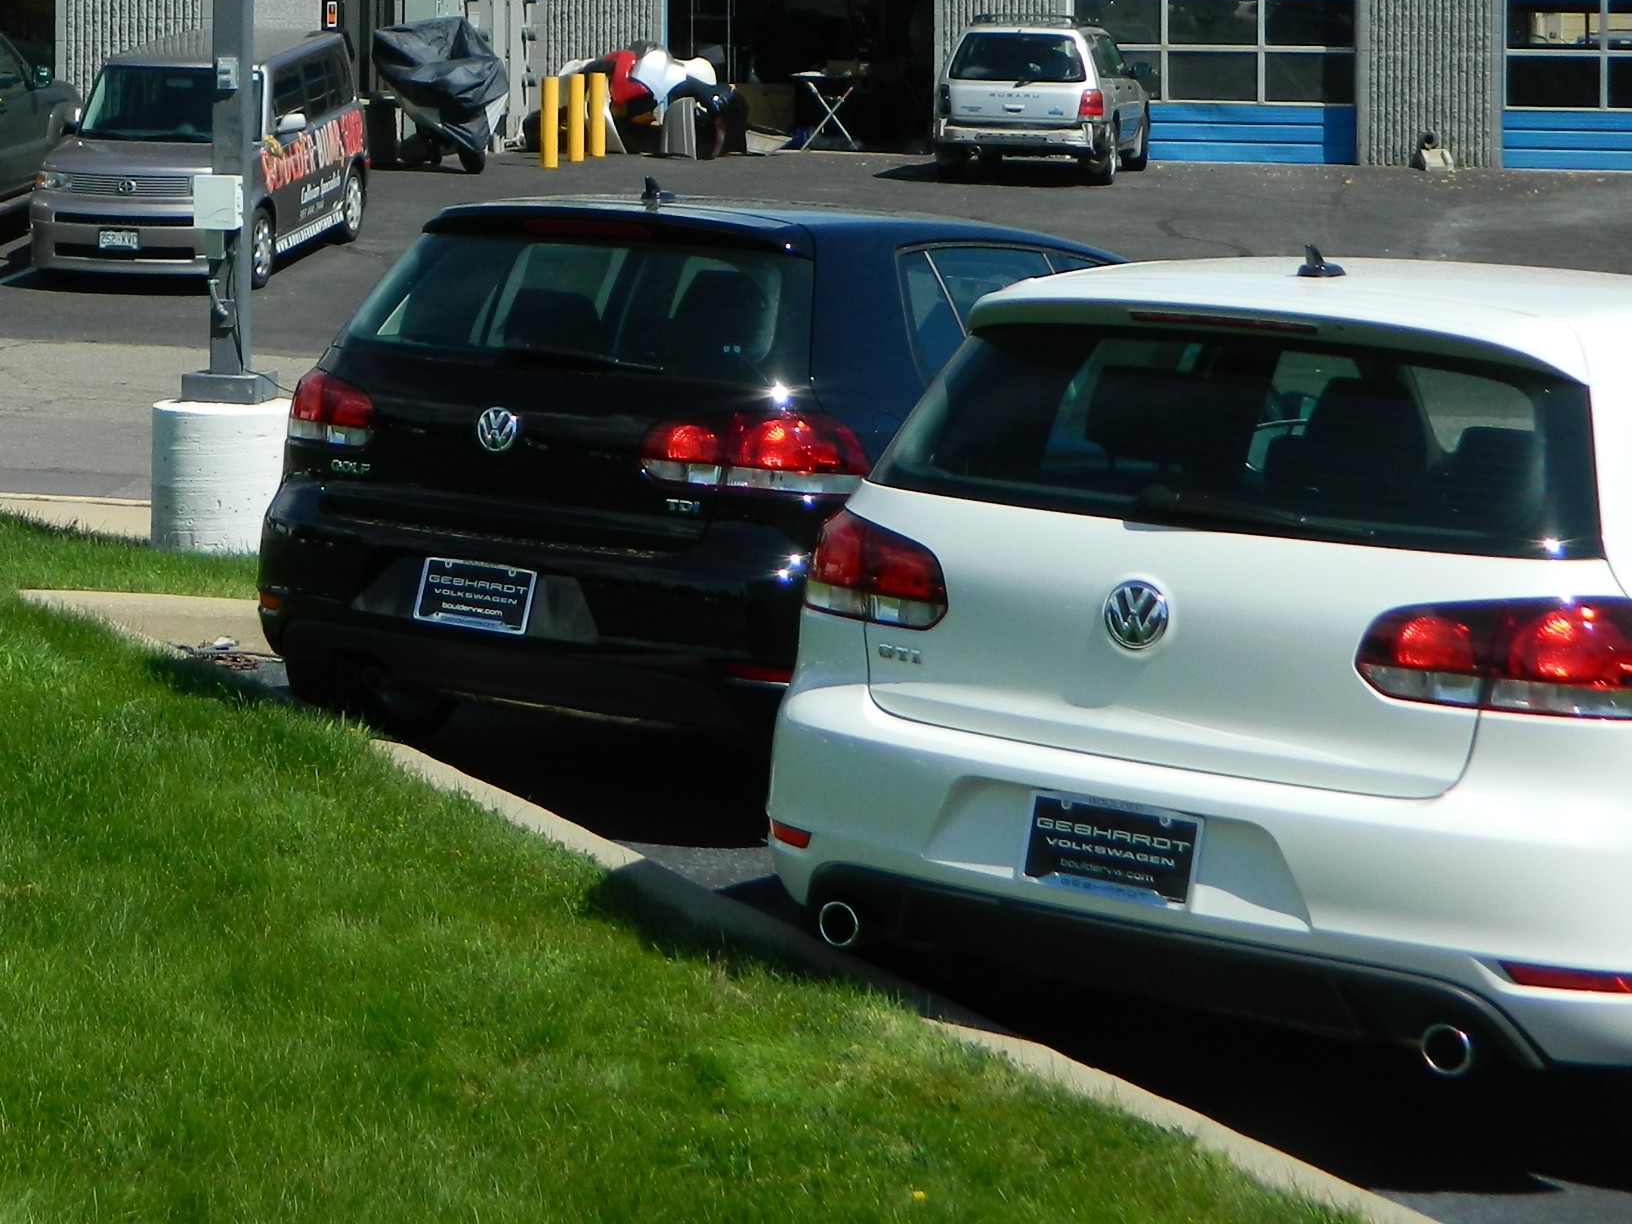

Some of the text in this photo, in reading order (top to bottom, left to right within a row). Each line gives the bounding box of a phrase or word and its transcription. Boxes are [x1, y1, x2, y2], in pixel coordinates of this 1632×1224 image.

[330, 459, 371, 474] GOLF
[665, 498, 701, 513] TDI
[428, 574, 528, 595] GEBHARDT
[434, 587, 518, 605] VOLKSWAGEN
[441, 601, 503, 616] bouldervw.com
[878, 643, 921, 664] GTI
[1036, 817, 1191, 853] GEBHARDT
[1046, 837, 1175, 867] VOLKSWAGEN
[1059, 858, 1155, 883] bouldervw.com
